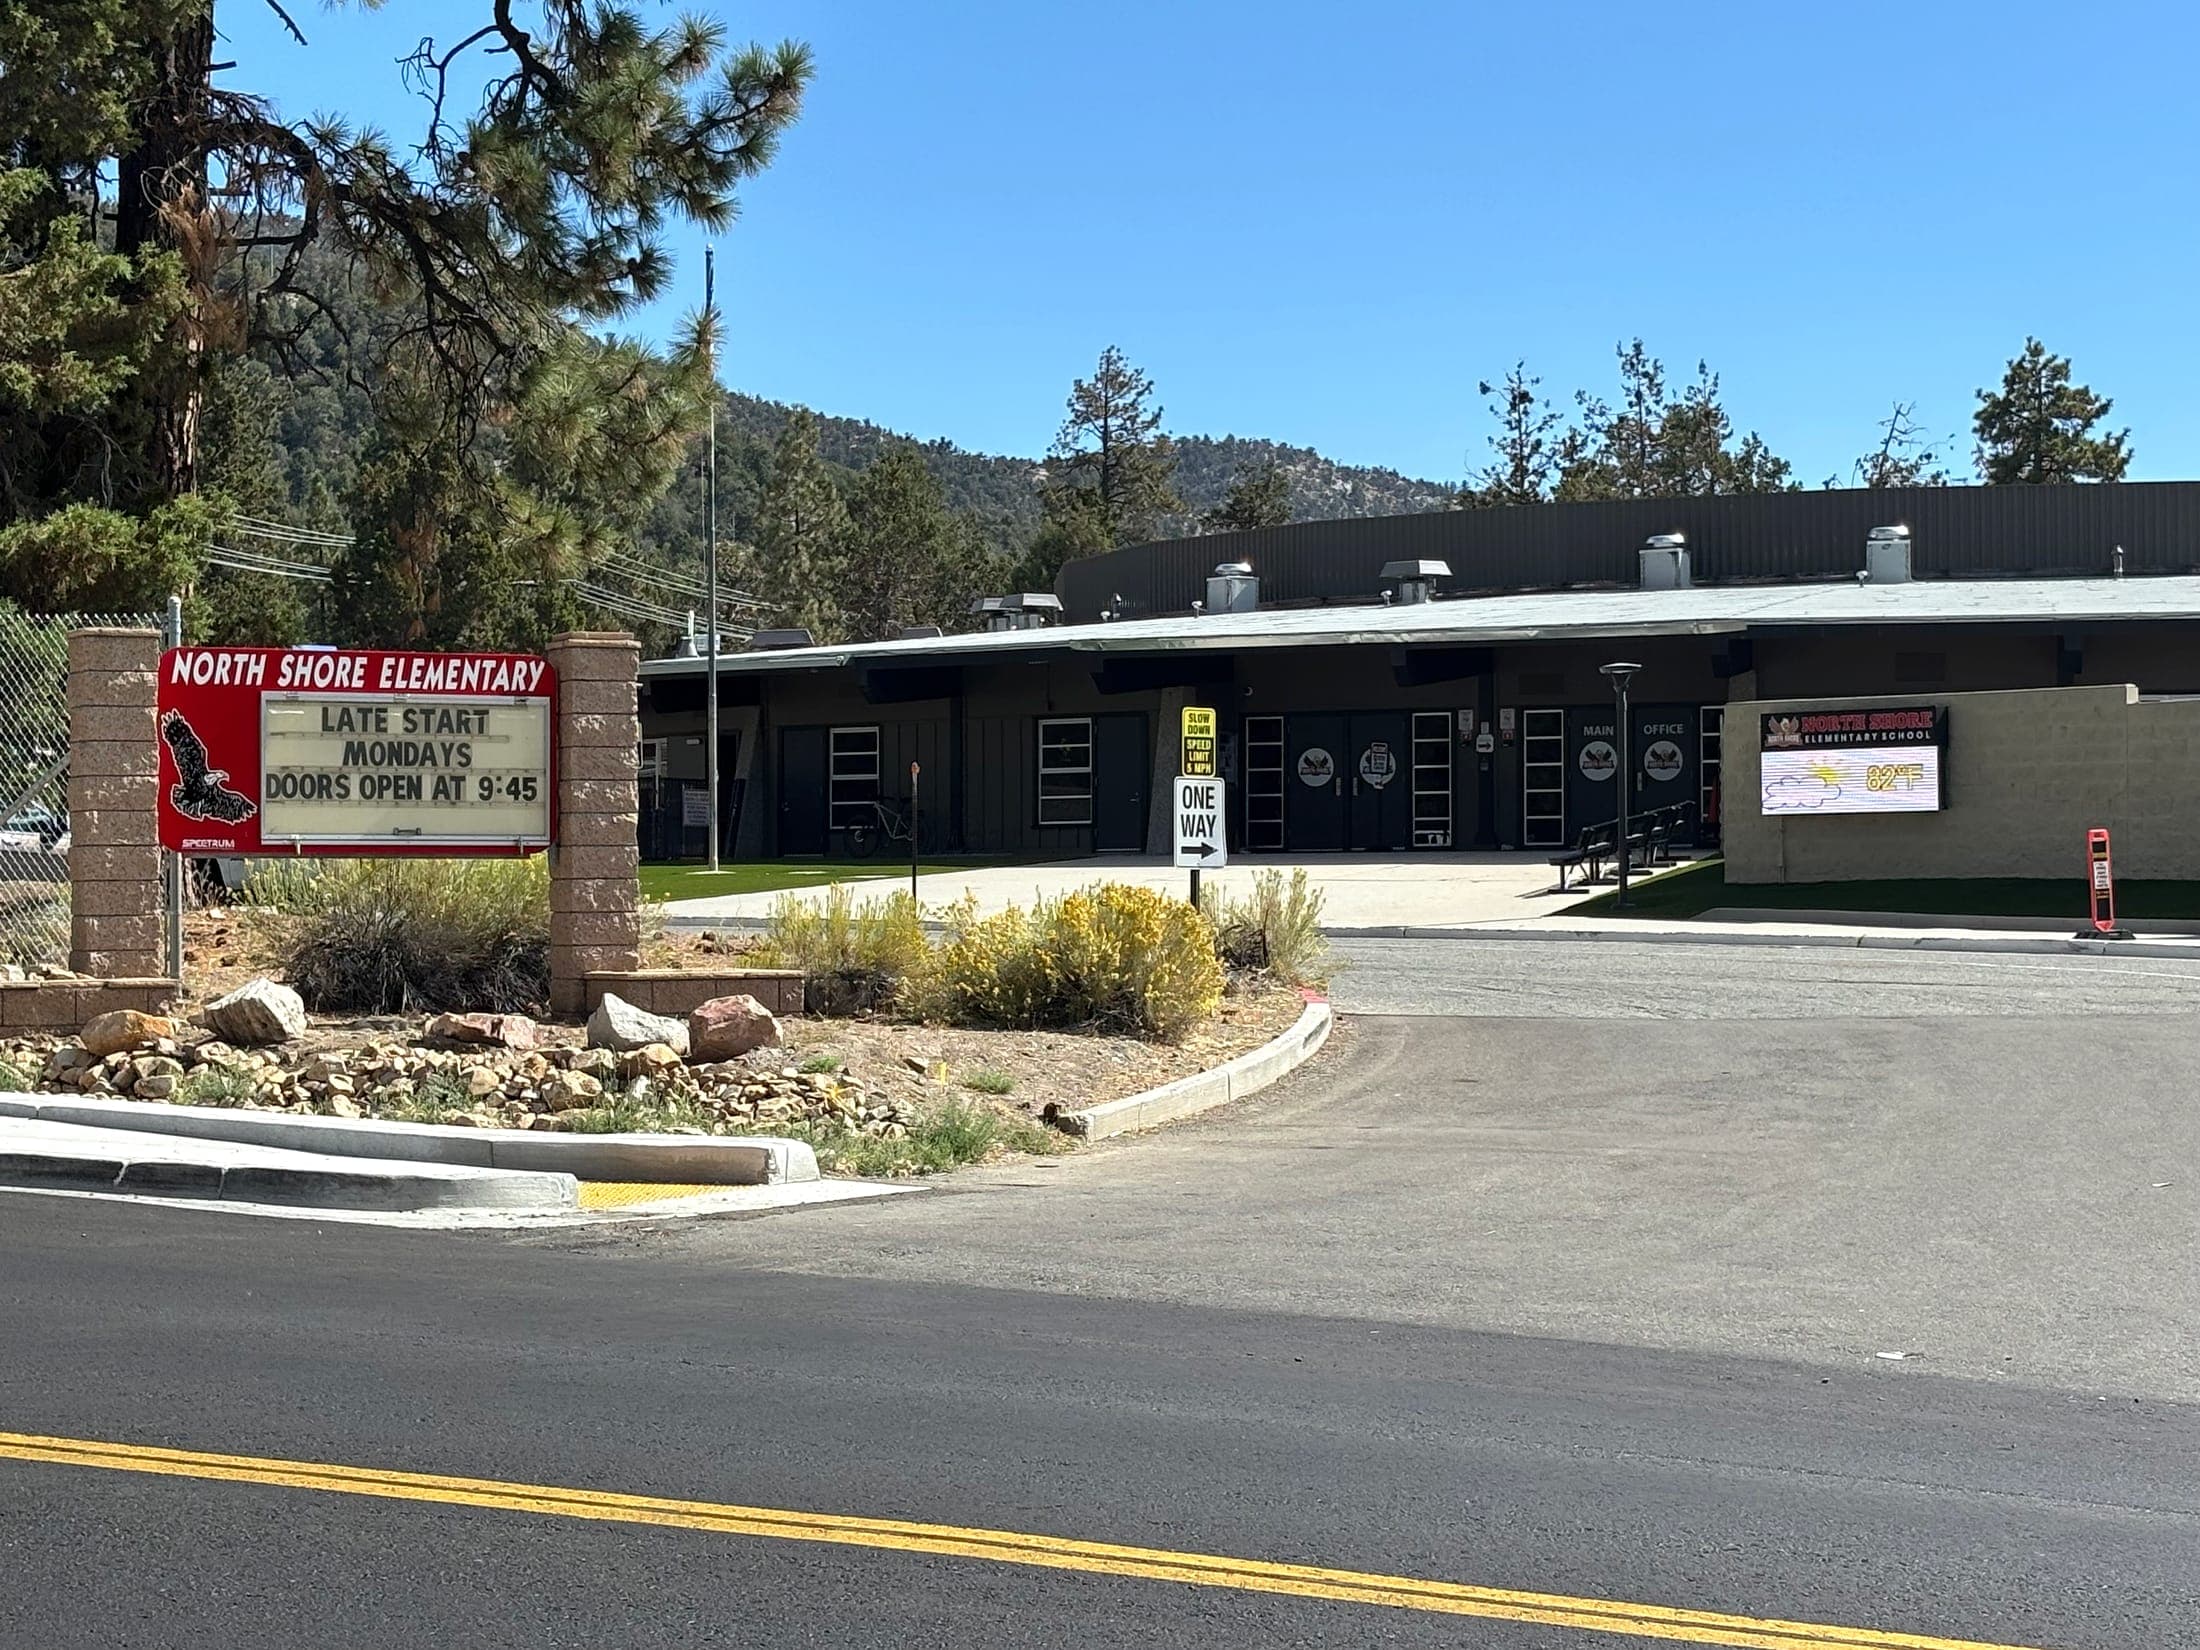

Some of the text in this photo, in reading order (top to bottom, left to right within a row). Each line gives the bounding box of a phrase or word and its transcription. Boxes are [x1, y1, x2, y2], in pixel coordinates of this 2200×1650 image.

[171, 651, 545, 692] NORTH SHORE ELEMENTARY
[321, 707, 490, 735] LATE START
[1188, 713, 1210, 723] SLOW
[1801, 711, 1933, 732] NORTH SHORE
[1188, 724, 1210, 735] DOWN
[1583, 723, 1685, 737] MAIN OFFICE
[1804, 730, 1931, 744] ELEMENTARY SCHOOL
[1186, 739, 1211, 750] SPEED
[342, 741, 472, 768] MONDAYS
[1188, 751, 1210, 761] LIMIT
[1194, 763, 1211, 774] MPH
[266, 773, 538, 801] DOORS OPEN AT 9:45
[1182, 785, 1215, 810] ONE
[1180, 814, 1217, 838] WAY
[182, 839, 235, 848] SPECTRUM
